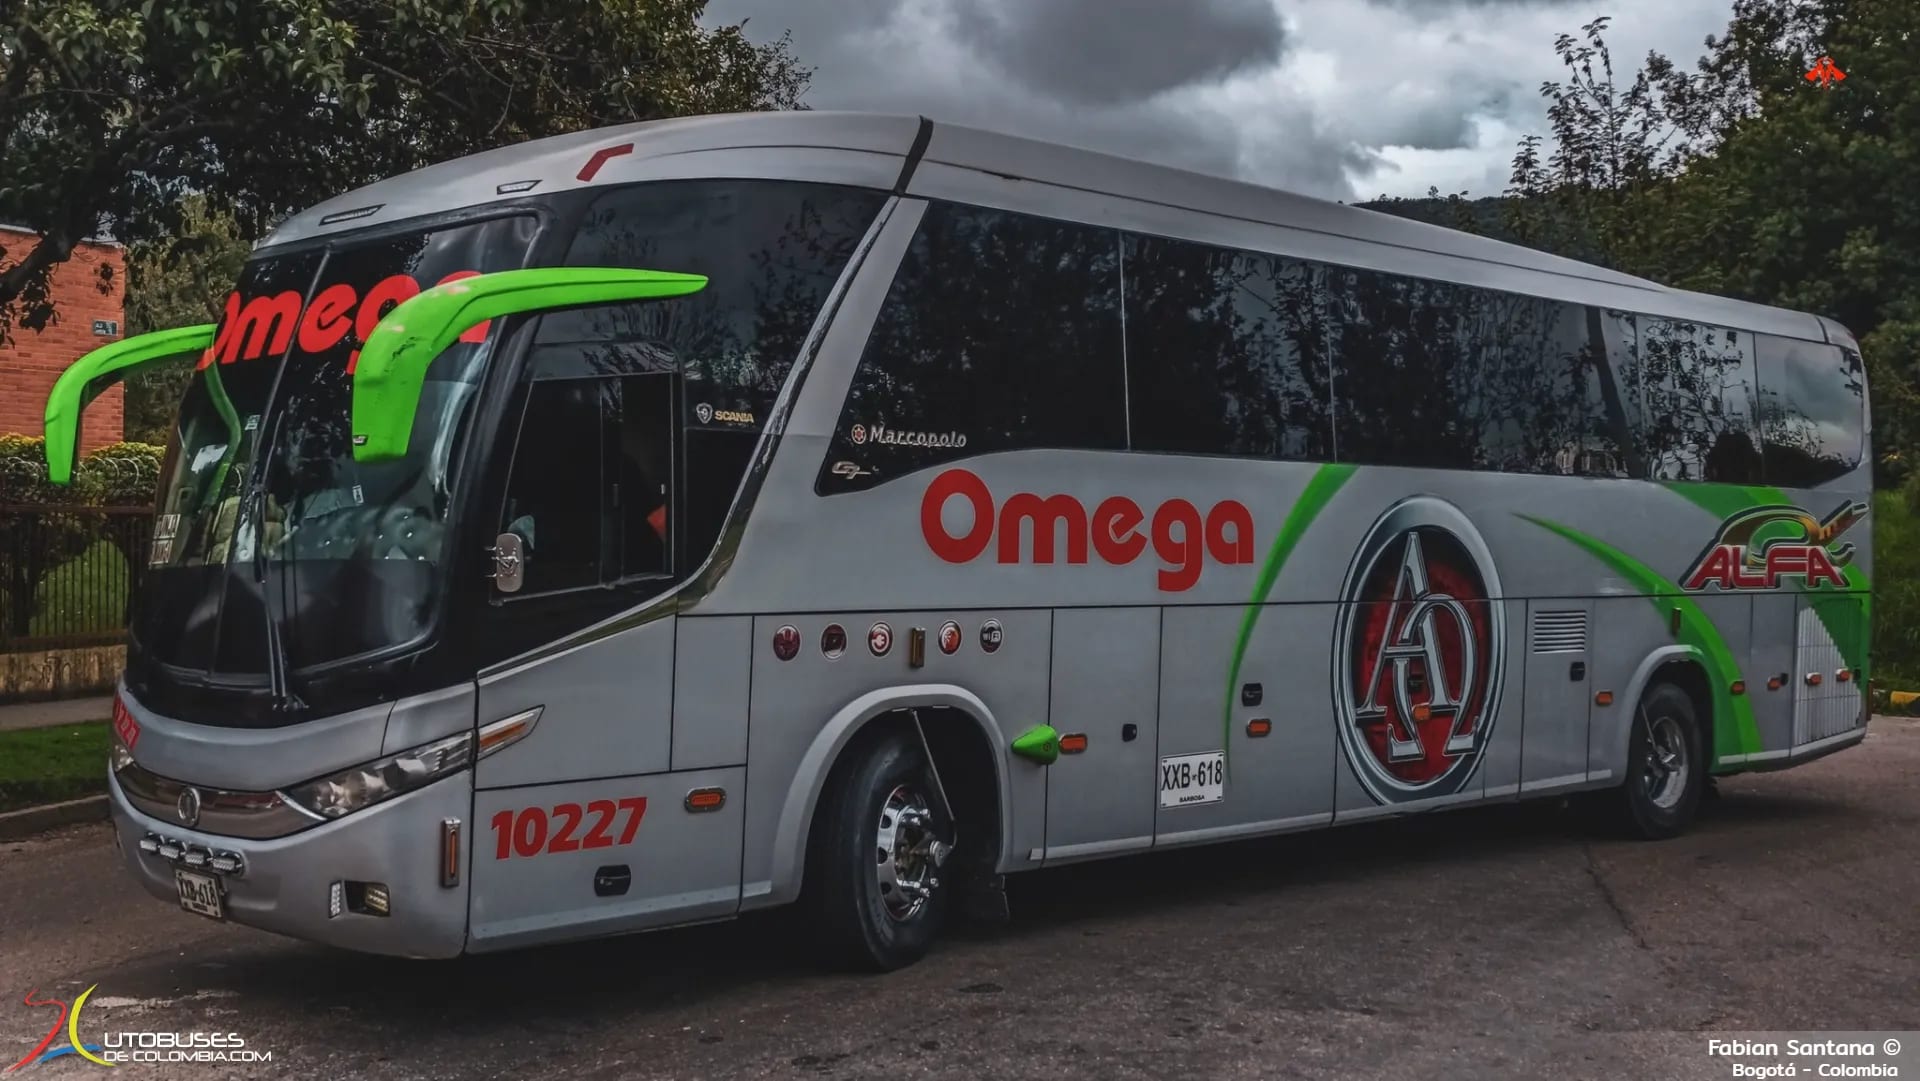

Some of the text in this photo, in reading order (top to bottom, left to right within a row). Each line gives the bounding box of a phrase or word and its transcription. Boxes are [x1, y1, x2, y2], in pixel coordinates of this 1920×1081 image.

[715, 410, 754, 424] SCANIA
[869, 424, 967, 448] Marcopolo
[920, 468, 1254, 592] Omega
[1684, 544, 1850, 591] ALFA
[491, 796, 648, 860] 10227
